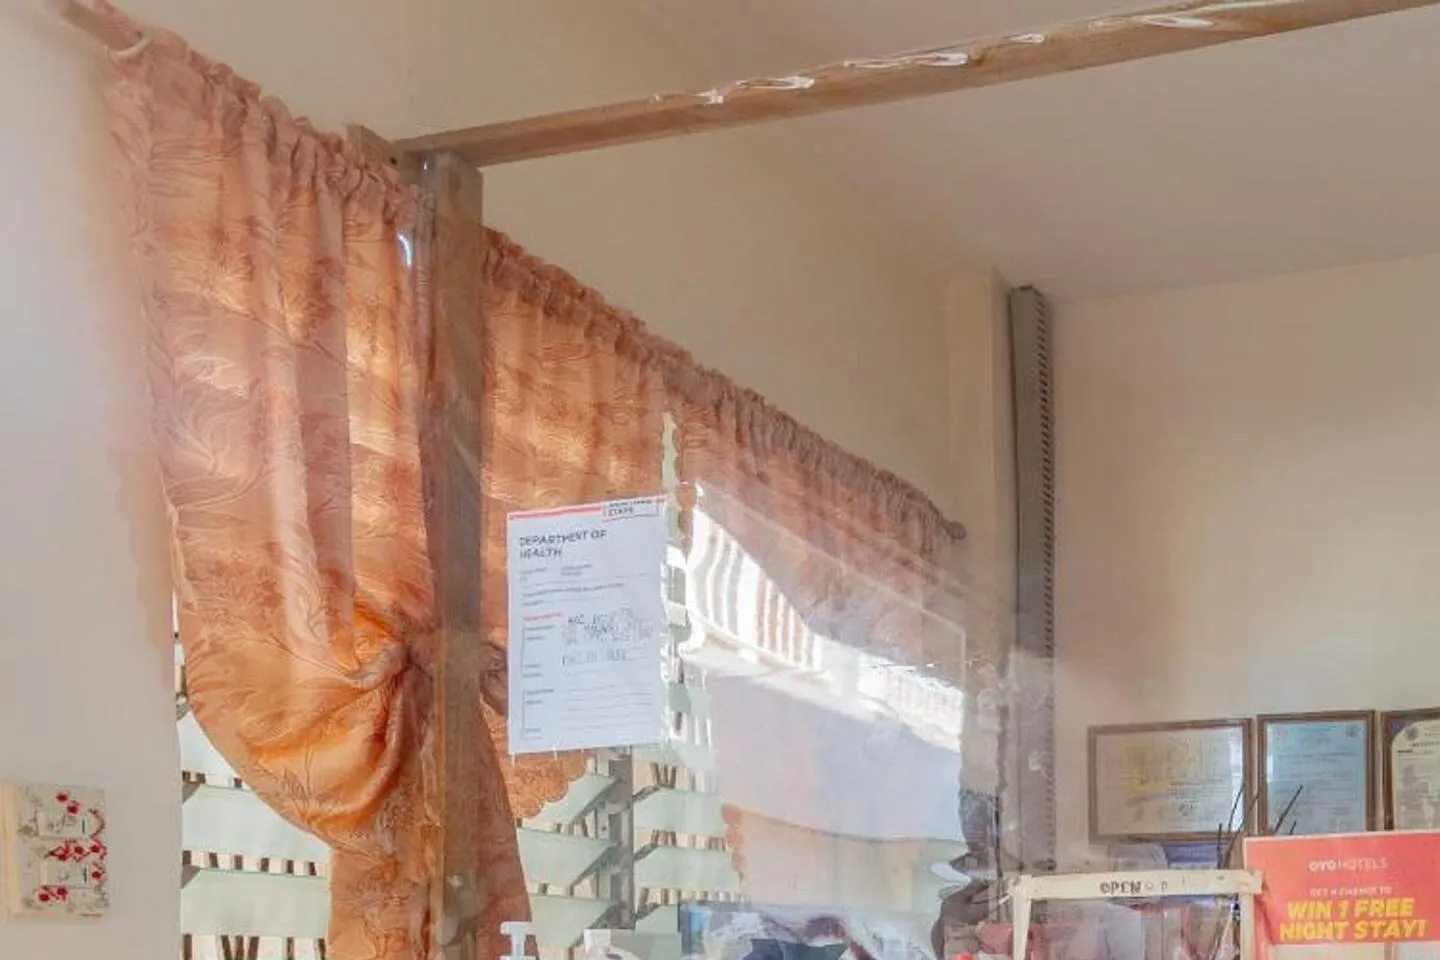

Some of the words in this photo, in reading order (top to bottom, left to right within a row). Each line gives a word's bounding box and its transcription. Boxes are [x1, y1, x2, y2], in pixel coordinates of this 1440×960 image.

[519, 531, 588, 547] DEPARTMENT
[591, 529, 607, 540] OF
[519, 548, 562, 560] HEALTH
[1308, 859, 1337, 873] OYO
[1337, 857, 1389, 871] HOTELS
[1100, 879, 1142, 895] OPEN
[1287, 900, 1332, 921] WIN
[1338, 899, 1349, 919] 1
[1354, 897, 1416, 919] FREE
[1279, 920, 1350, 942] NIGHT
[1353, 919, 1427, 940] STAY!
